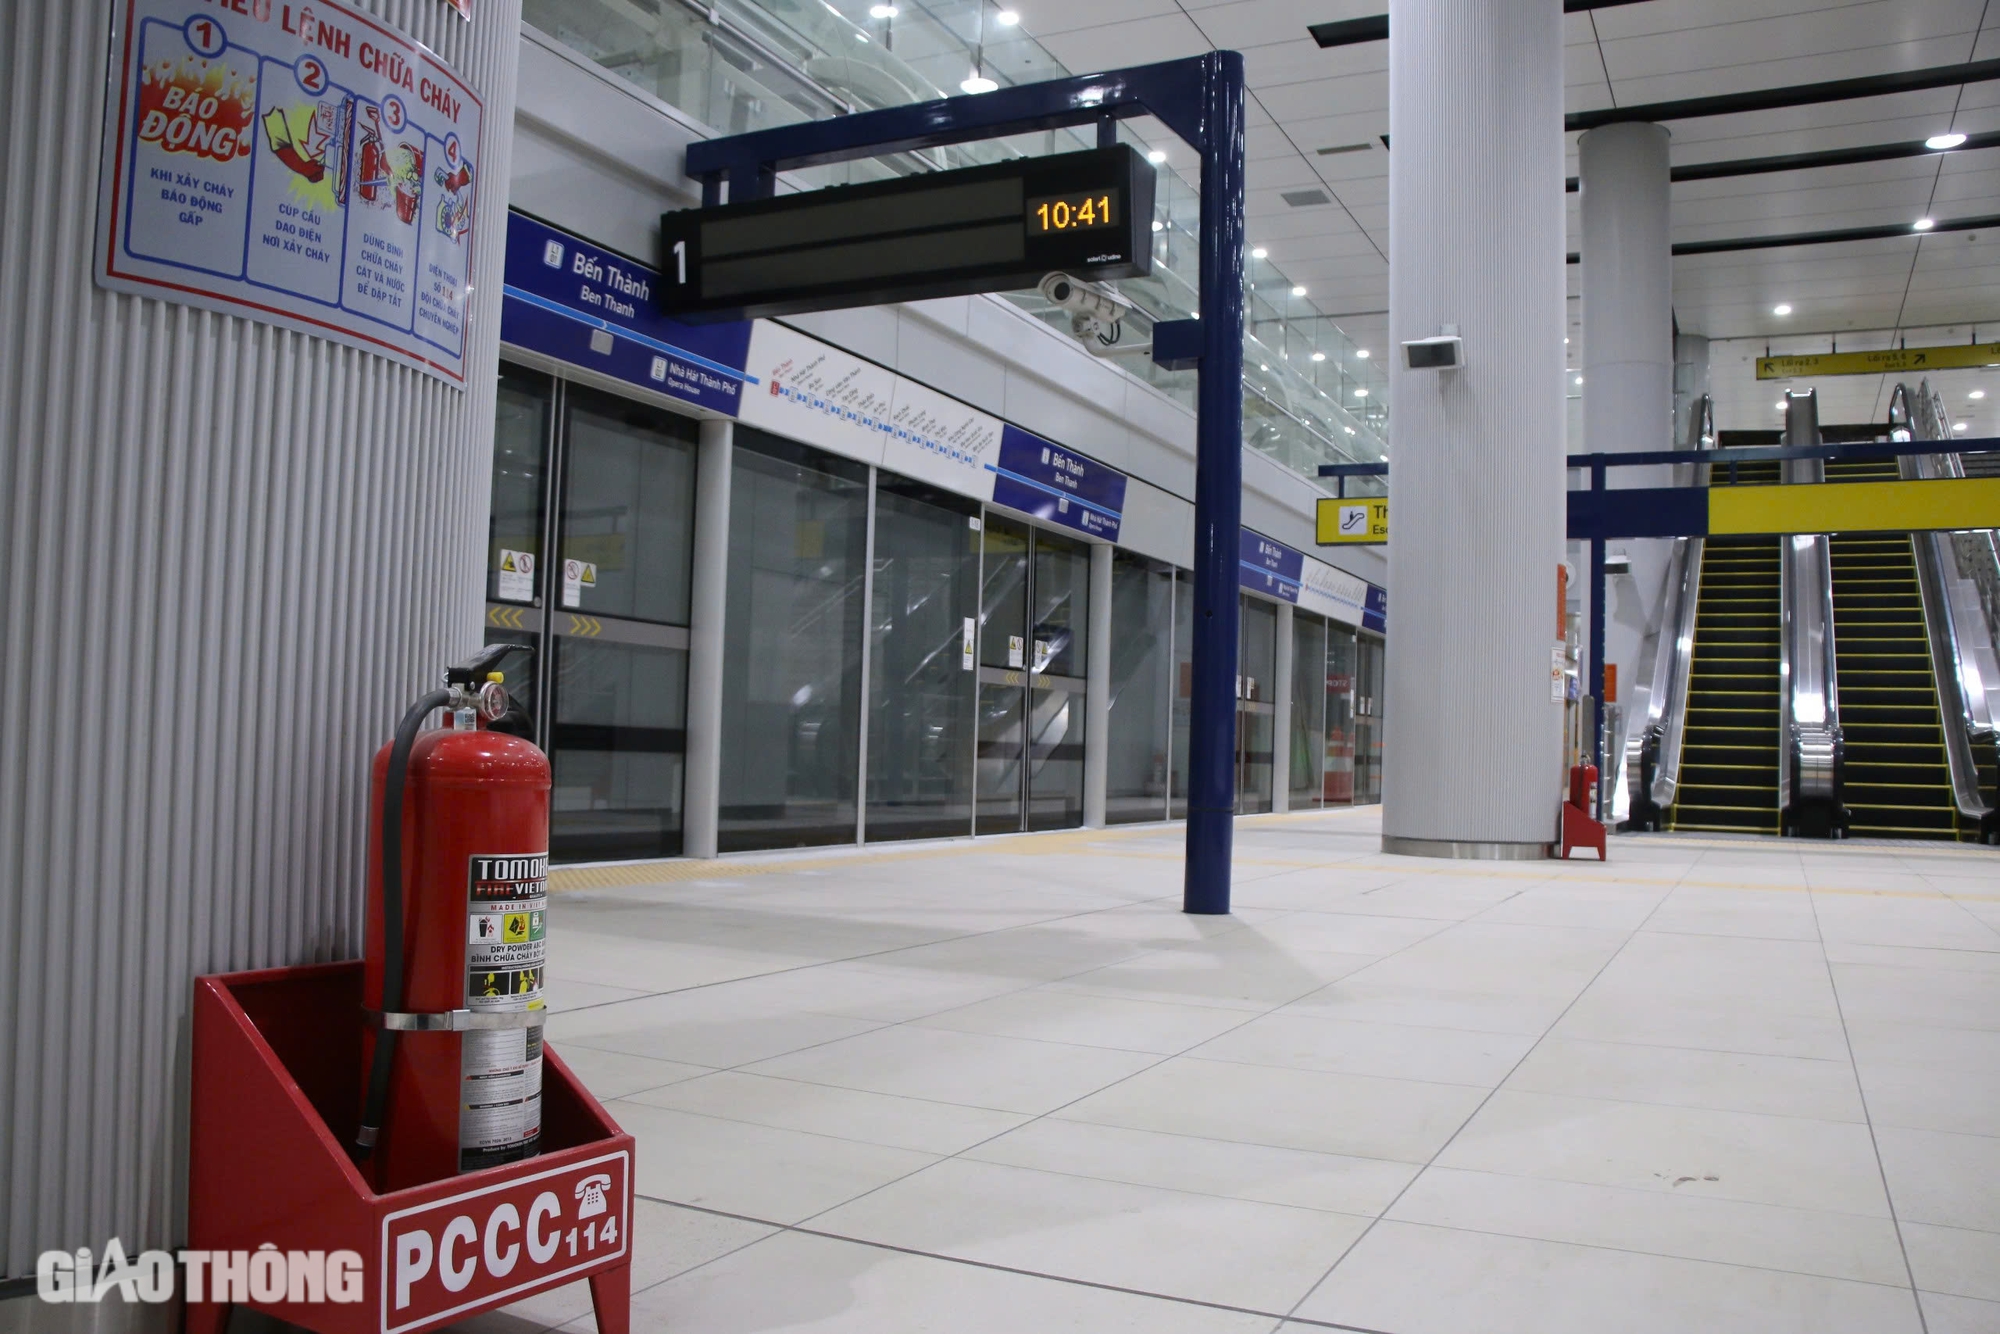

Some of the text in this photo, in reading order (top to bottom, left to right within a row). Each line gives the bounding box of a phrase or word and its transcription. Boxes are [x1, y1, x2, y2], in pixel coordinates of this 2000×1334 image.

[196, 22, 212, 48] 1
[282, 4, 350, 58] LỆNH
[359, 42, 414, 94] CHỮA
[420, 77, 461, 123] CHÁY
[303, 62, 320, 89] 2
[162, 86, 219, 119] BÁO
[388, 101, 400, 126] 3
[139, 109, 237, 156] ĐỘNG
[448, 141, 457, 163] 4
[150, 167, 234, 199] KHI XẢY CHÁY
[161, 188, 223, 214] BÁO ĐỘNG
[279, 203, 299, 217] CÚP
[1037, 196, 1109, 230] 10:41
[179, 210, 203, 226] GẤP
[275, 220, 322, 243] DAO ĐIỆN
[305, 247, 330, 263] CHÁY
[674, 241, 686, 284] 1
[573, 252, 650, 301] Bến Thành
[580, 285, 635, 319] Ben Thanh
[669, 362, 685, 378] Nhà
[700, 373, 721, 390] Thành
[721, 380, 738, 396] Phố
[1053, 453, 1066, 468] Bến
[1055, 472, 1065, 484] Ben
[471, 954, 493, 962] BÌNH
[494, 952, 515, 962] CHỮA
[517, 951, 532, 960] CHÁY
[508, 943, 532, 952] POWDER
[396, 1191, 618, 1310] PCCC 114
